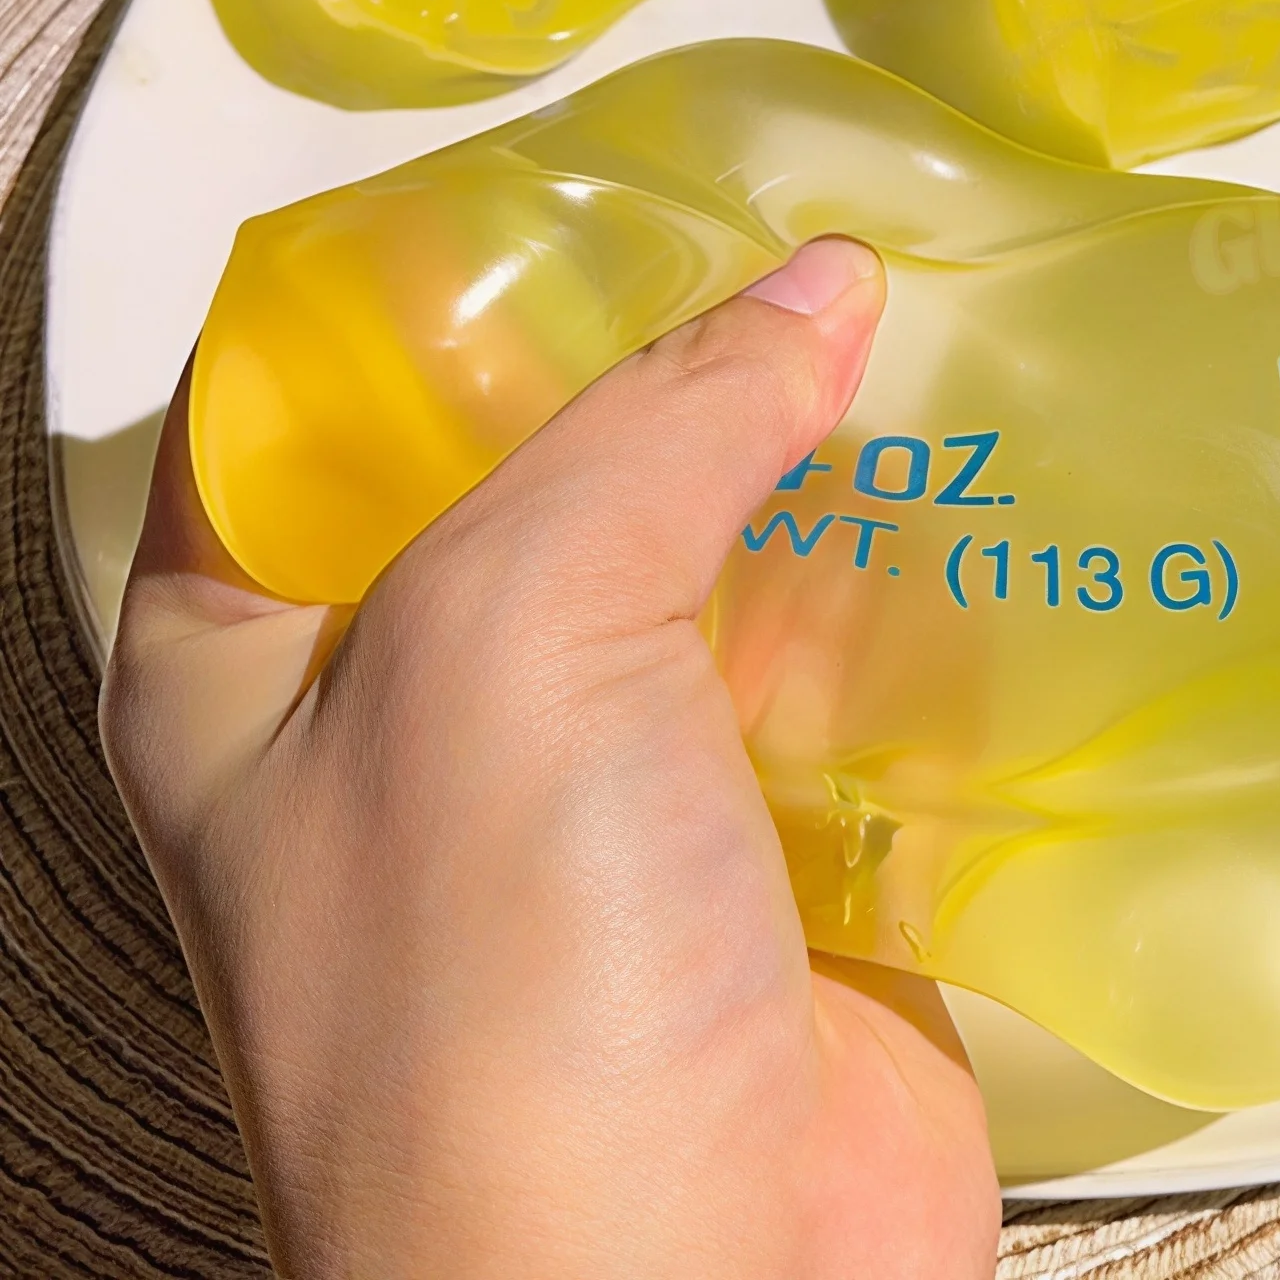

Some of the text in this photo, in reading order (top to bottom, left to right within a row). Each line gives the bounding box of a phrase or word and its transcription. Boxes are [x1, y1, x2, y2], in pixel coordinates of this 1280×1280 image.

[852, 430, 1016, 506] OZ.
[741, 510, 1239, 621] WT. (113 G)
